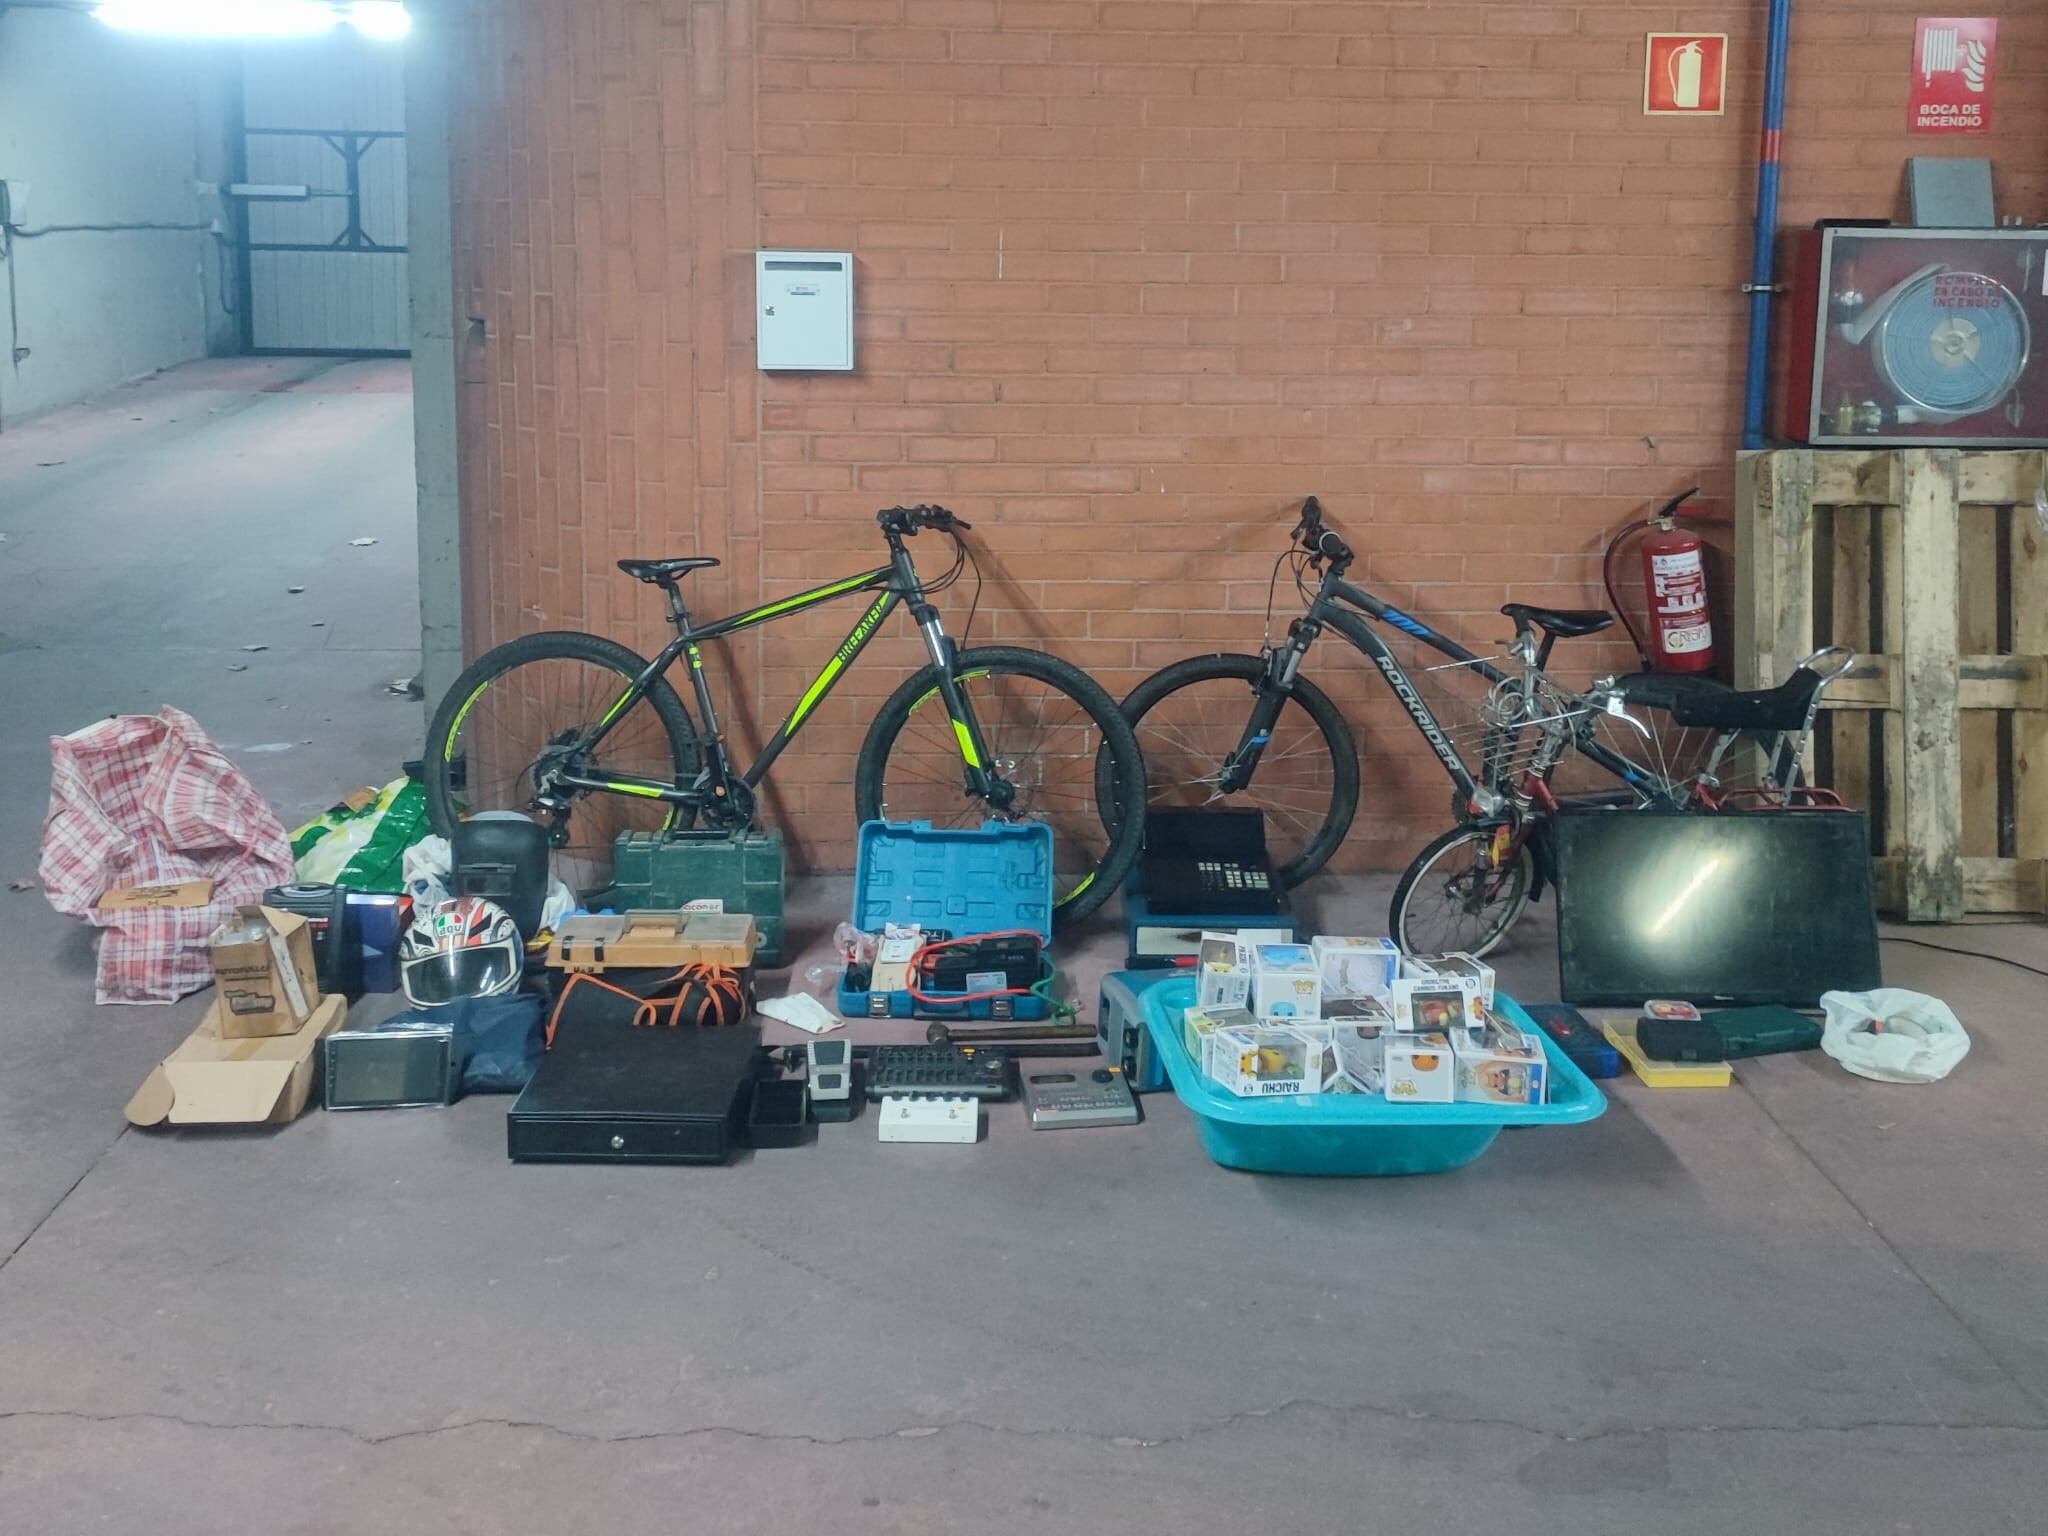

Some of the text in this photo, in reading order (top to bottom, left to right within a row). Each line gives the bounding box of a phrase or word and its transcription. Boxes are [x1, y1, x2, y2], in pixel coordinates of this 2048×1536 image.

[1920, 104, 1981, 115] BOCA DE
[1917, 116, 1982, 127] INCENDIO
[1951, 287, 1985, 297] CASO
[1933, 297, 2001, 308] INCENDIO
[1375, 655, 1461, 770] ROCKRIDER
[1261, 1081, 1300, 1094] RAICHU
